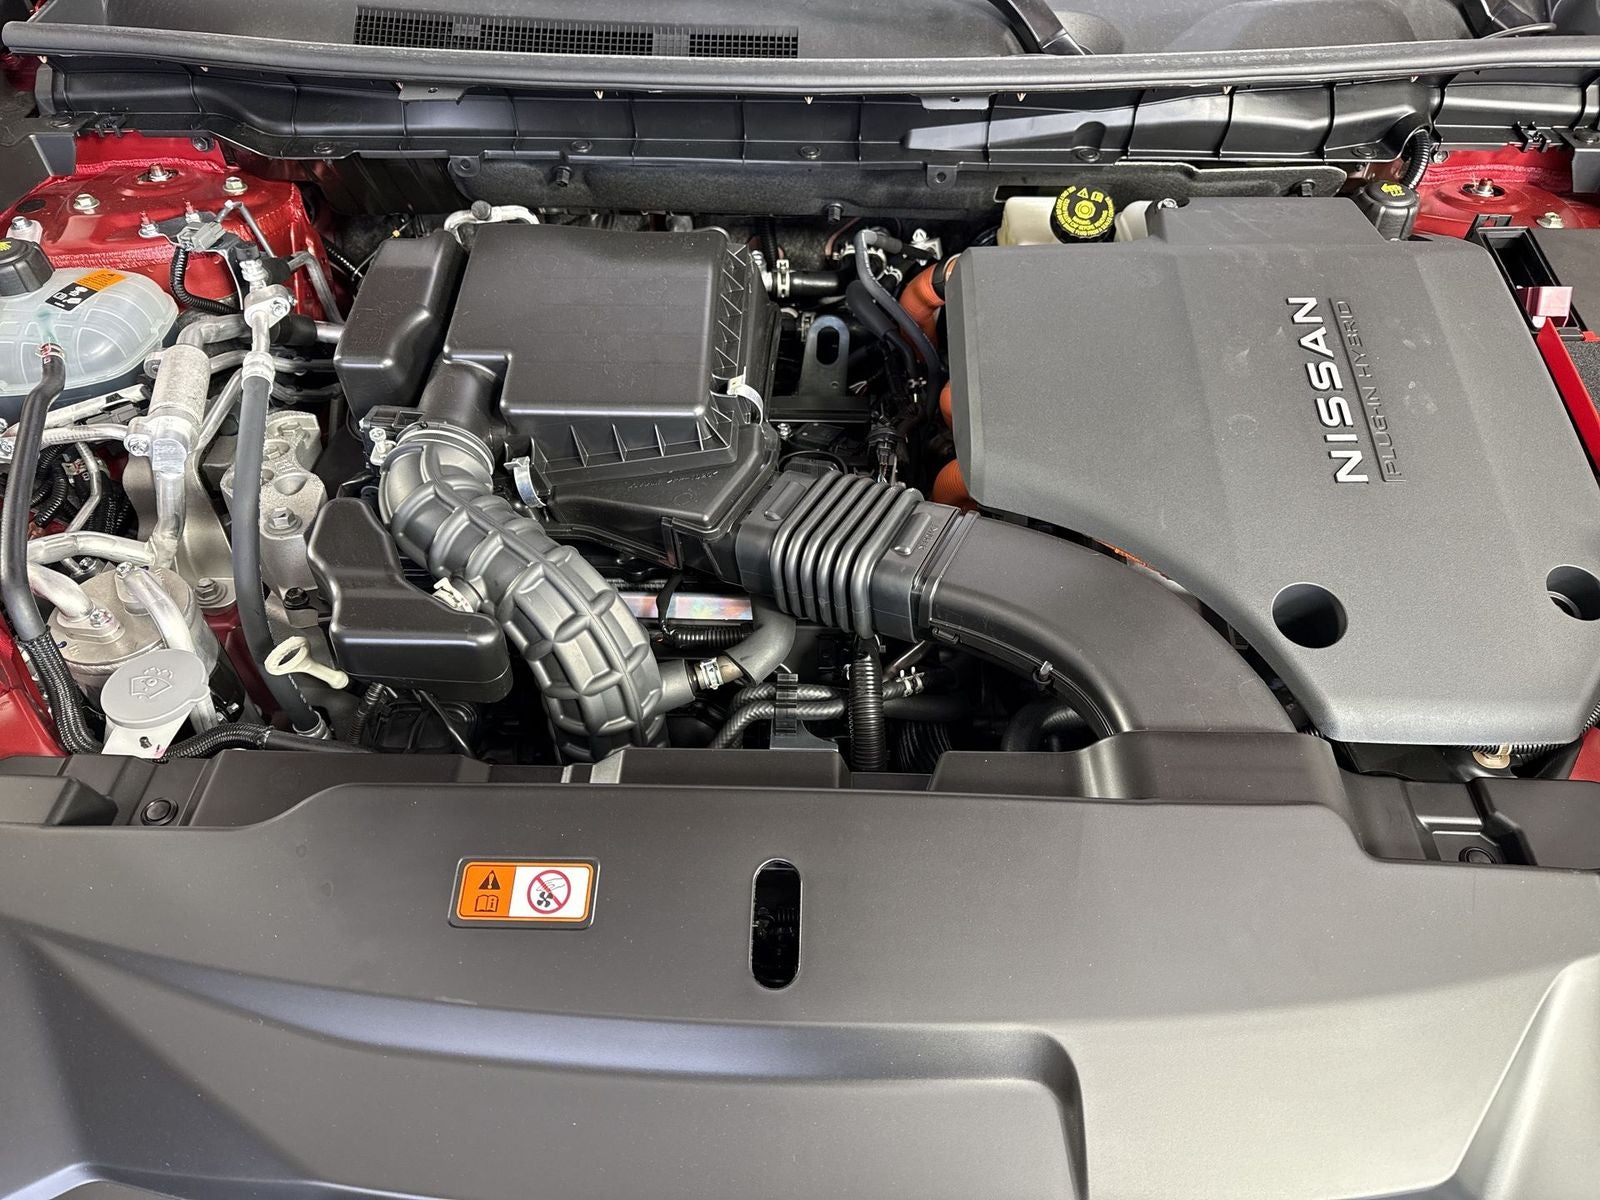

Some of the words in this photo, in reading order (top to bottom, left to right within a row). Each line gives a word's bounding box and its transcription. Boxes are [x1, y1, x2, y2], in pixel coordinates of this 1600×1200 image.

[1337, 301, 1372, 378] HYBRID
[1287, 297, 1369, 484] NISSAN
[1362, 386, 1401, 476] PLUG-IN
